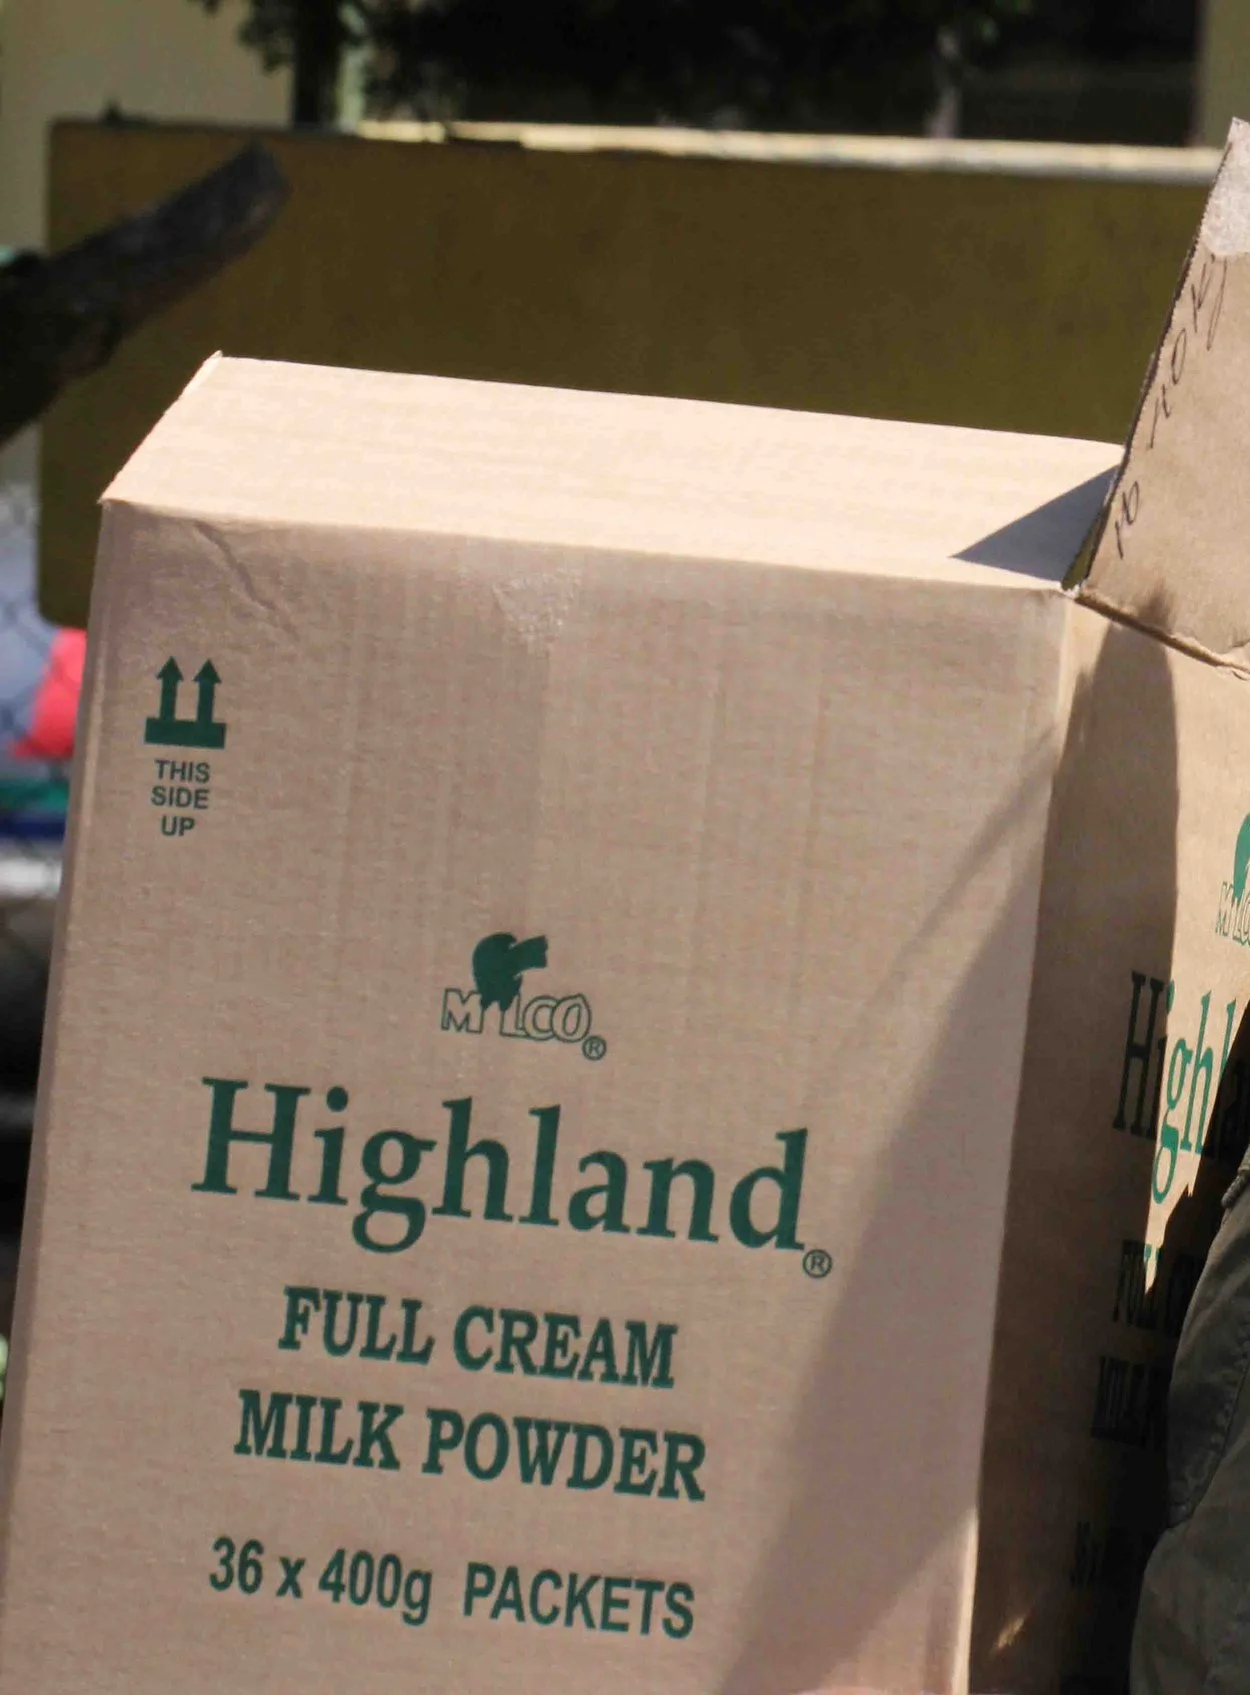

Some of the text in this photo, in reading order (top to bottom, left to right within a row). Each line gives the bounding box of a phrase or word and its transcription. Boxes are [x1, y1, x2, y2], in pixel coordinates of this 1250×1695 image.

[150, 784, 210, 811] SIDE
[154, 759, 210, 785] THIS
[158, 815, 195, 837] UP
[440, 987, 592, 1043] MILCO
[190, 1077, 810, 1254] Highland
[276, 1285, 679, 1389] FULL CREAM
[232, 1388, 708, 1503] MILK POWDER
[208, 1536, 696, 1640] 36 x 400g PACKETS
